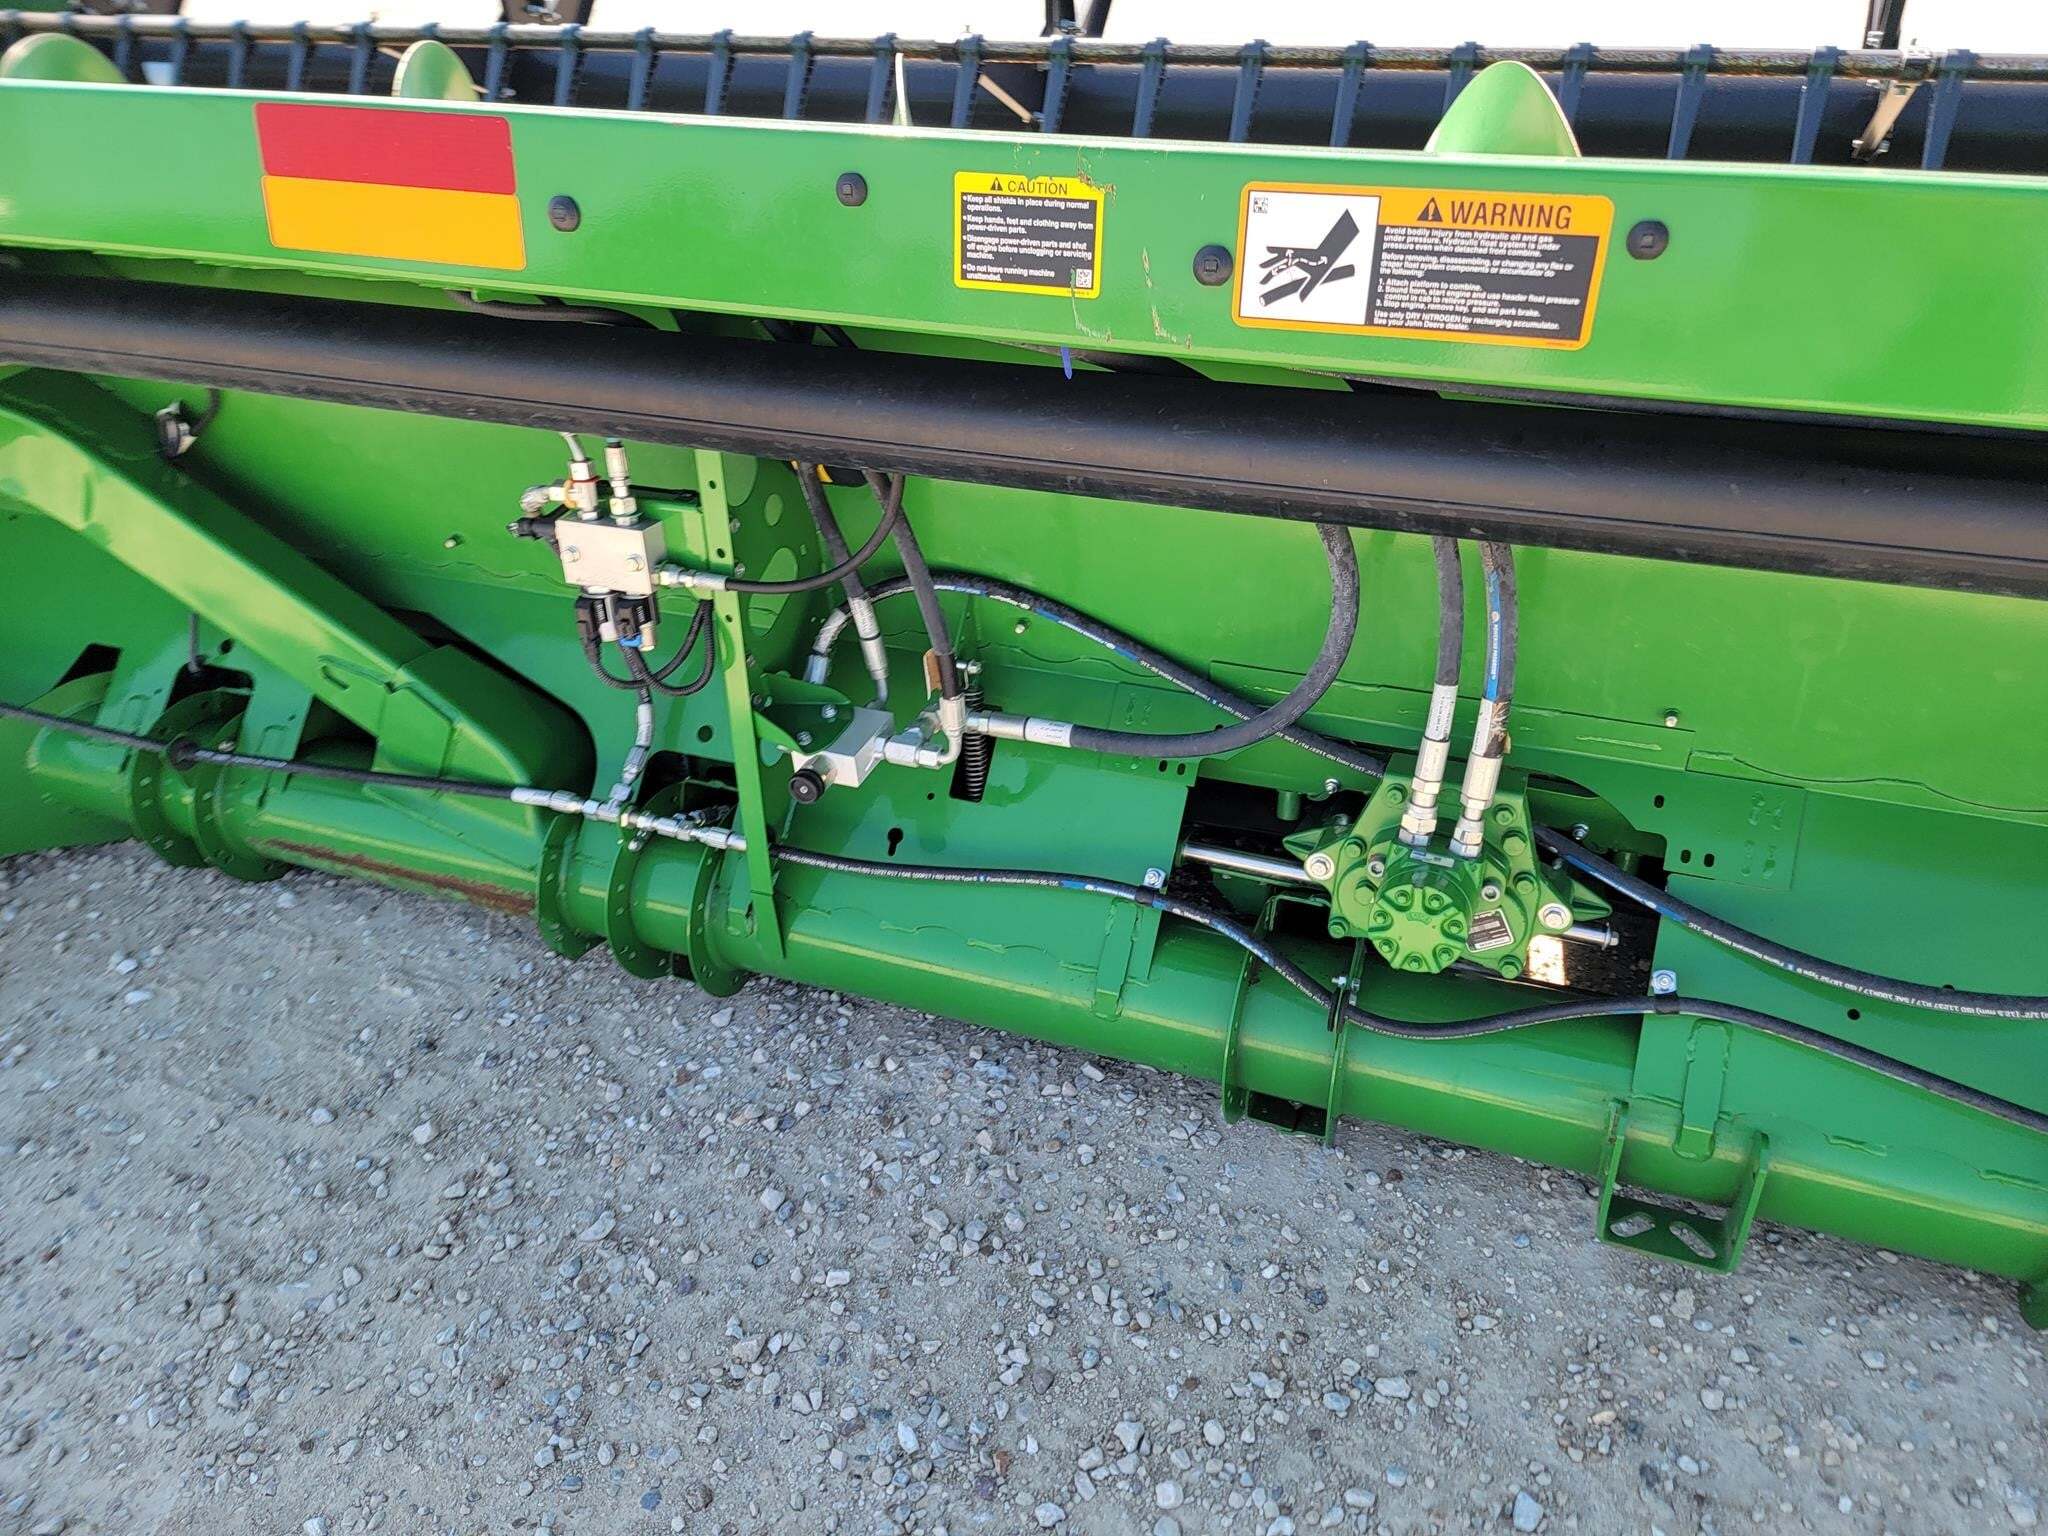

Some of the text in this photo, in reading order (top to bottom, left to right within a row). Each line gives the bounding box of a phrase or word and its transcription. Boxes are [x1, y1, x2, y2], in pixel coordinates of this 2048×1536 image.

[1008, 180, 1068, 195] CAUTION
[967, 195, 984, 204] Keep
[1026, 199, 1042, 207] place
[1044, 200, 1065, 210] during
[1451, 201, 1572, 230] WARNING
[967, 215, 983, 224] Keep
[1033, 219, 1059, 229] clothing
[1407, 228, 1430, 237] bodily
[1432, 228, 1453, 238] injury
[1455, 229, 1472, 238] from
[1474, 232, 1509, 240] hydraulic
[1063, 250, 1092, 260] servicing
[1005, 268, 1028, 277] running
[1410, 280, 1439, 288] platform
[1389, 312, 1404, 320] only
[1422, 313, 1461, 322] NITROGEN
